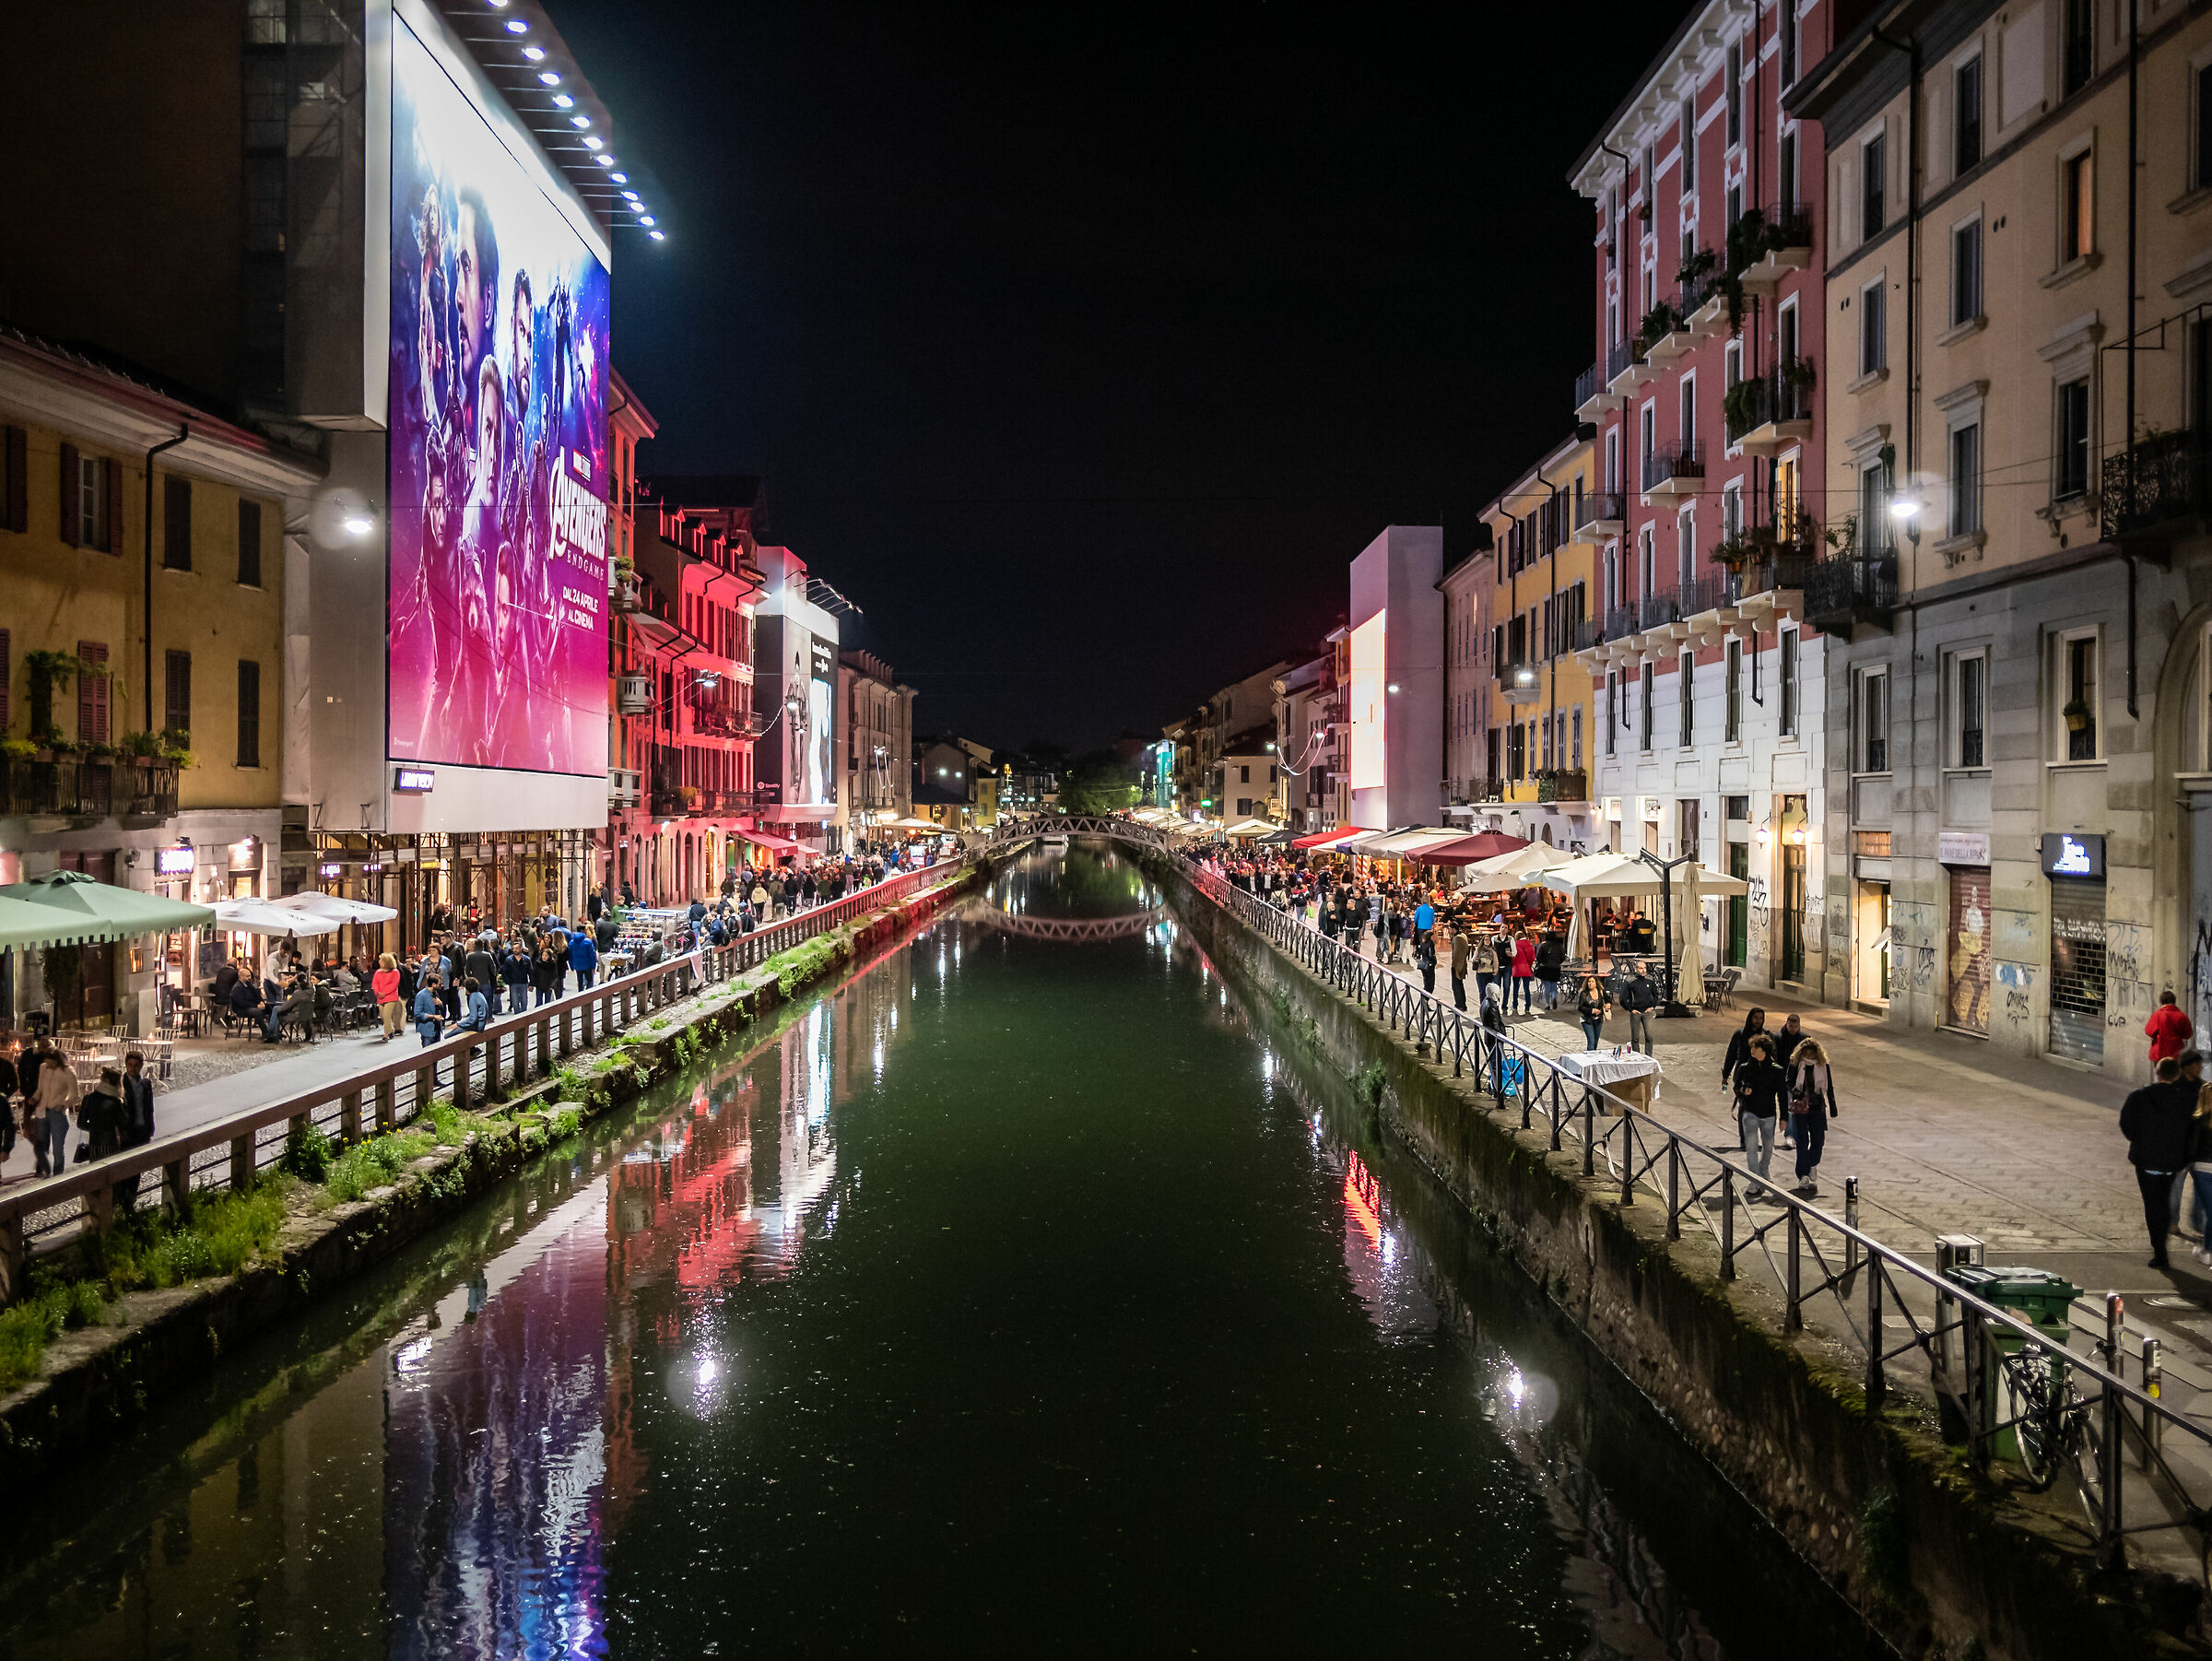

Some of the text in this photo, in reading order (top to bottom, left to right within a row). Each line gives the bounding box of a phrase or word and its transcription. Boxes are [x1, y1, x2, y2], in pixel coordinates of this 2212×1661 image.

[548, 446, 607, 561] AVENGERS
[567, 549, 604, 581] ENDGAME
[563, 585, 599, 614] DAL 24 APRILE
[568, 608, 594, 631] AL CINEMA
